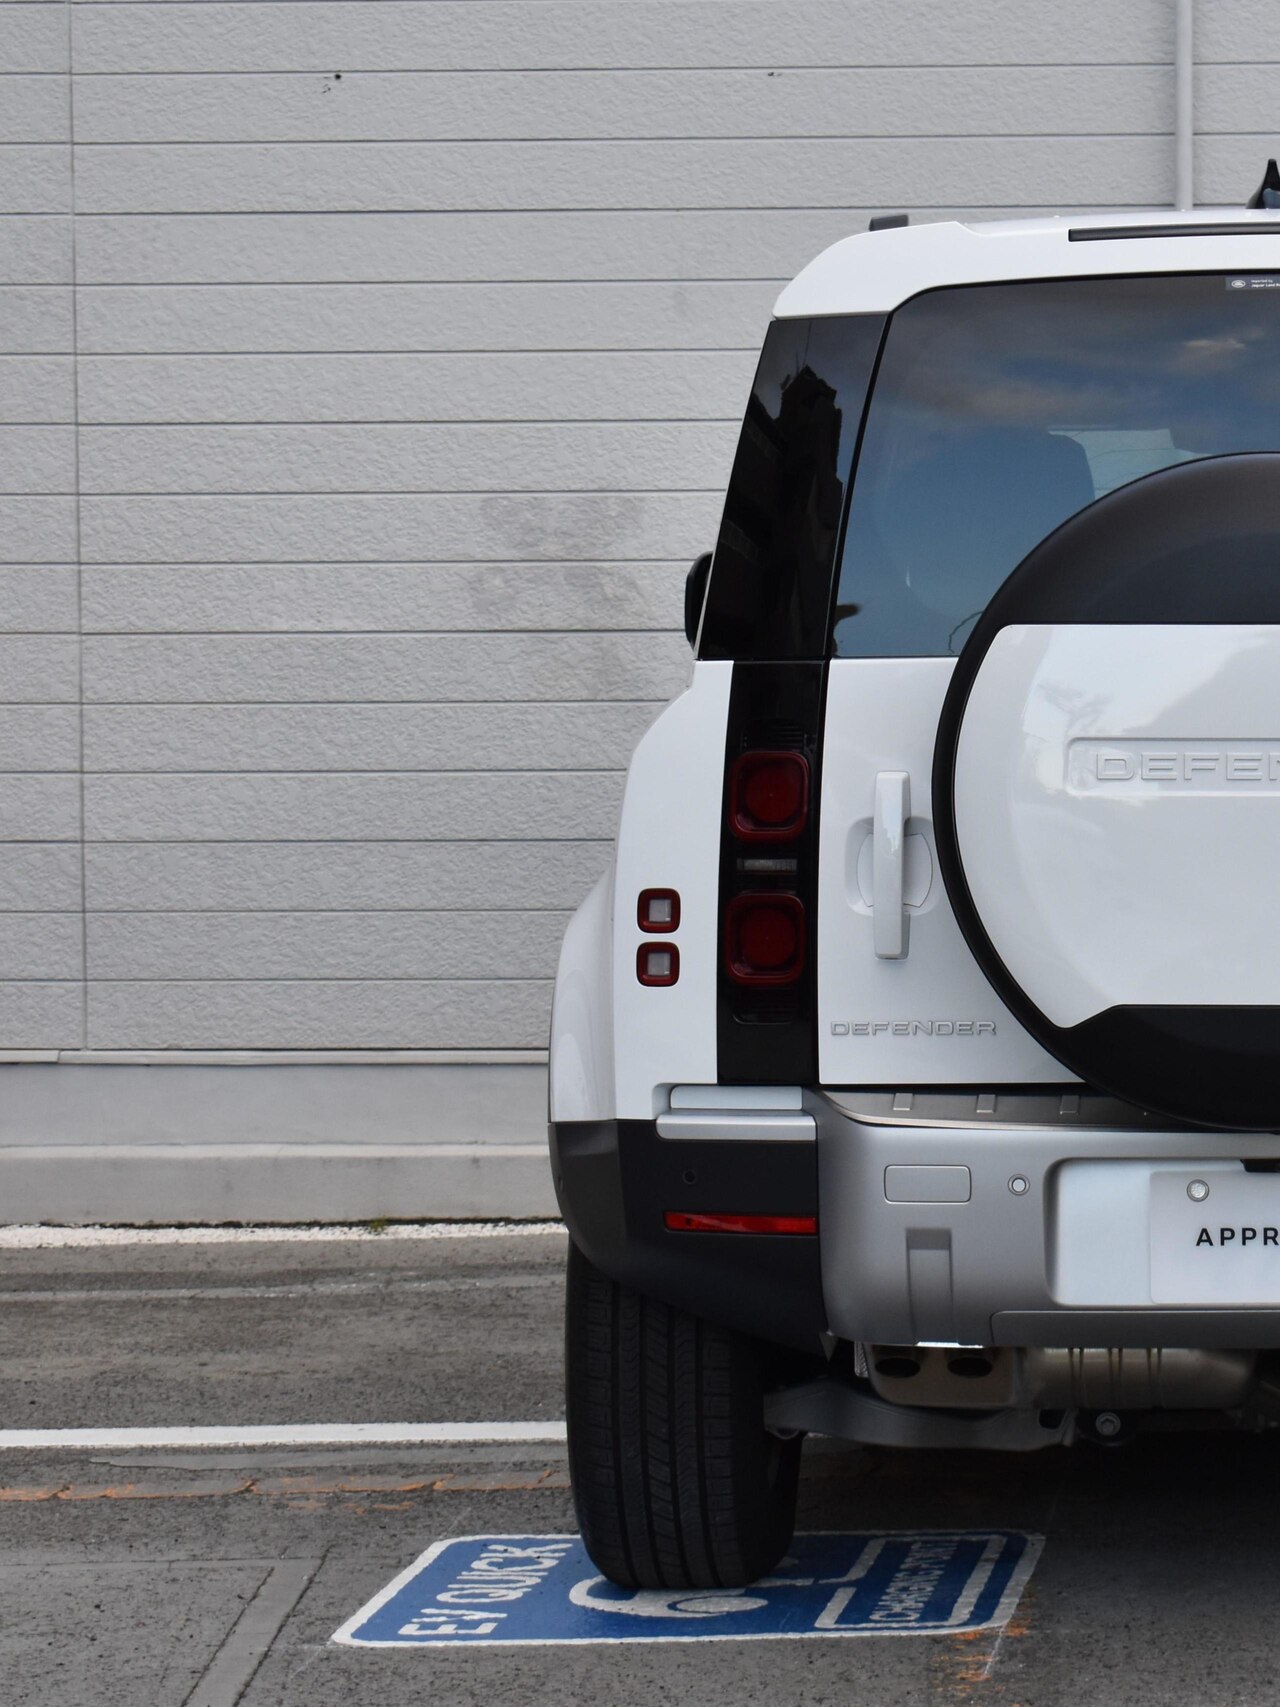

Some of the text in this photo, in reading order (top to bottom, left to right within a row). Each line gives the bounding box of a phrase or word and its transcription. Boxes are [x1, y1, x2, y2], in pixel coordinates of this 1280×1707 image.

[830, 1020, 997, 1036] DEFENDER
[398, 1543, 573, 1635] EV QUICK
